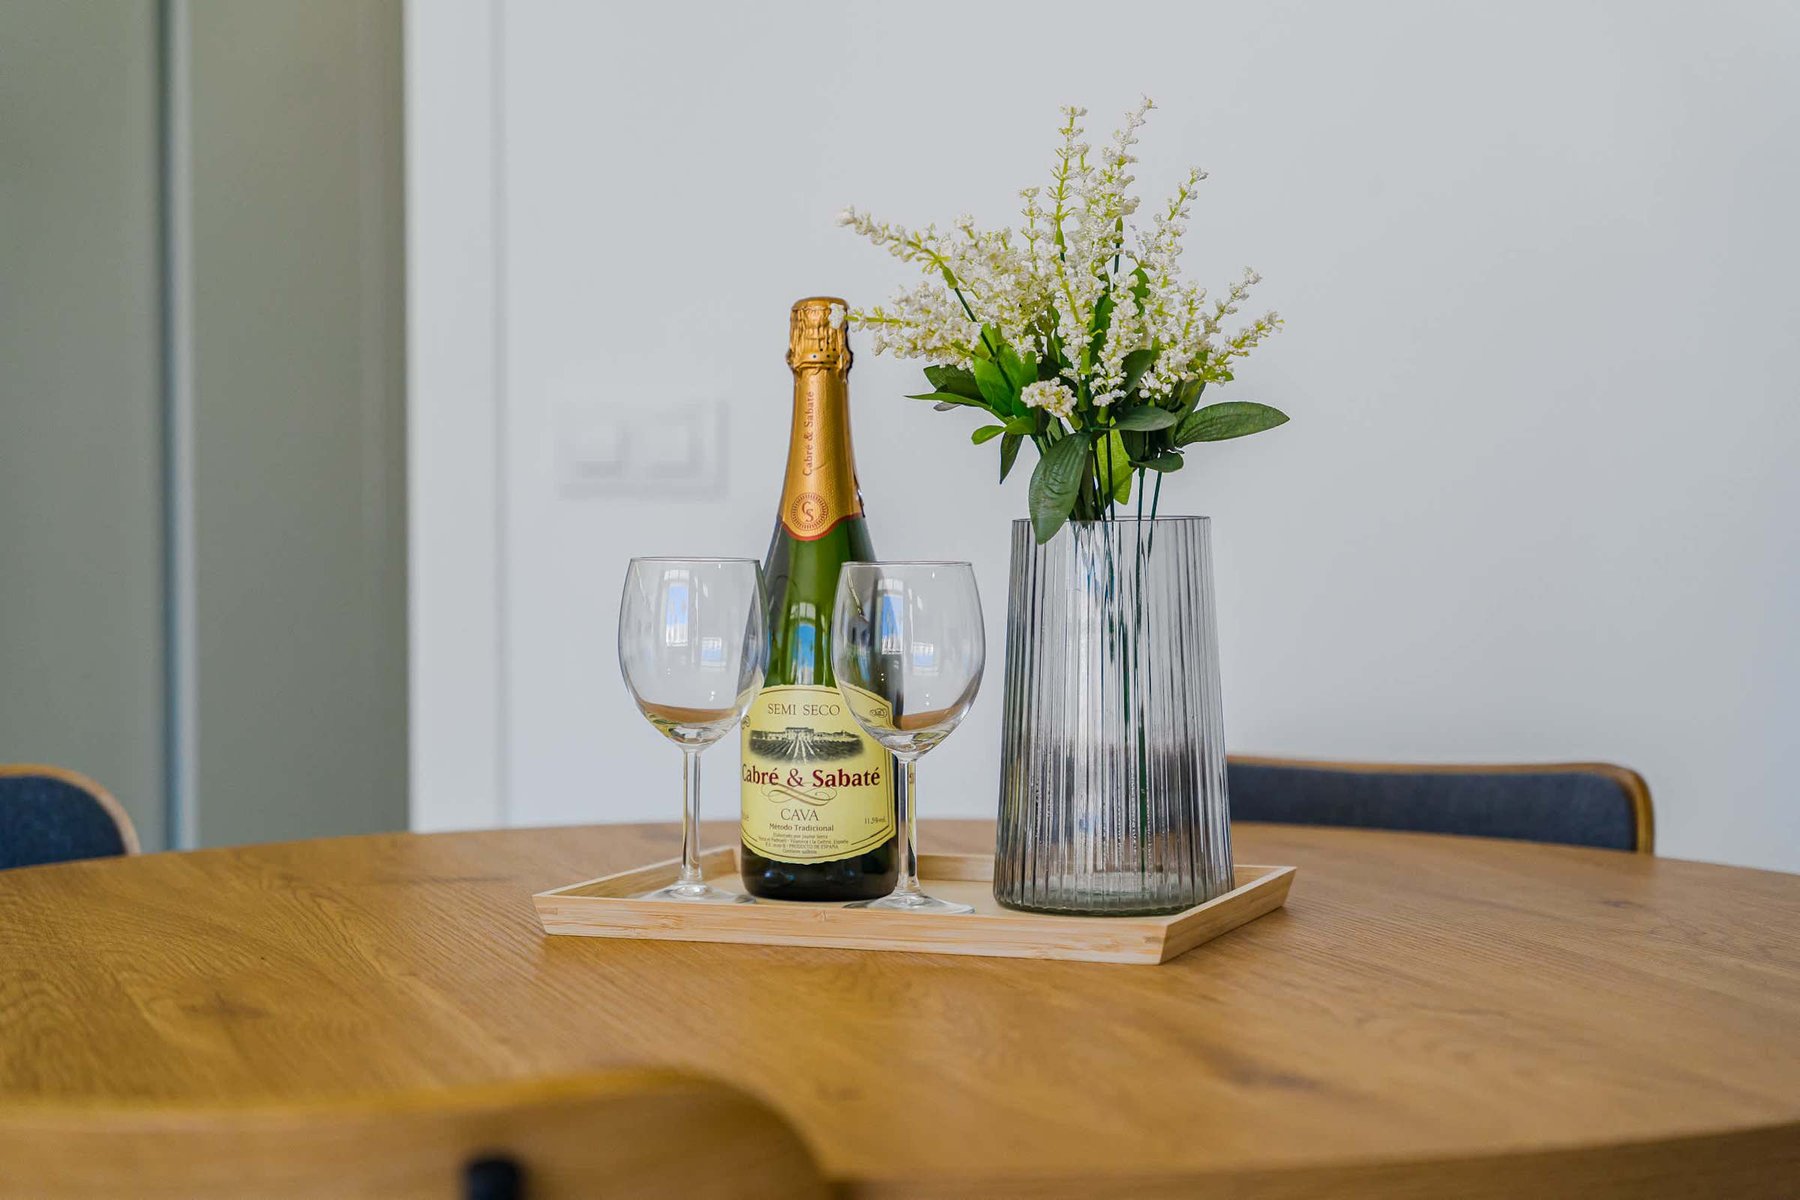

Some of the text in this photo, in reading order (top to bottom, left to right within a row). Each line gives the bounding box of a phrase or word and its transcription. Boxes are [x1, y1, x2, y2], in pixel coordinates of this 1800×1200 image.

[803, 432, 813, 441] &
[767, 703, 841, 716] SEMI SECO
[742, 763, 881, 788] Cabré & Sabaté
[780, 808, 819, 821] CAVA
[769, 822, 834, 832] Método Tradicional
